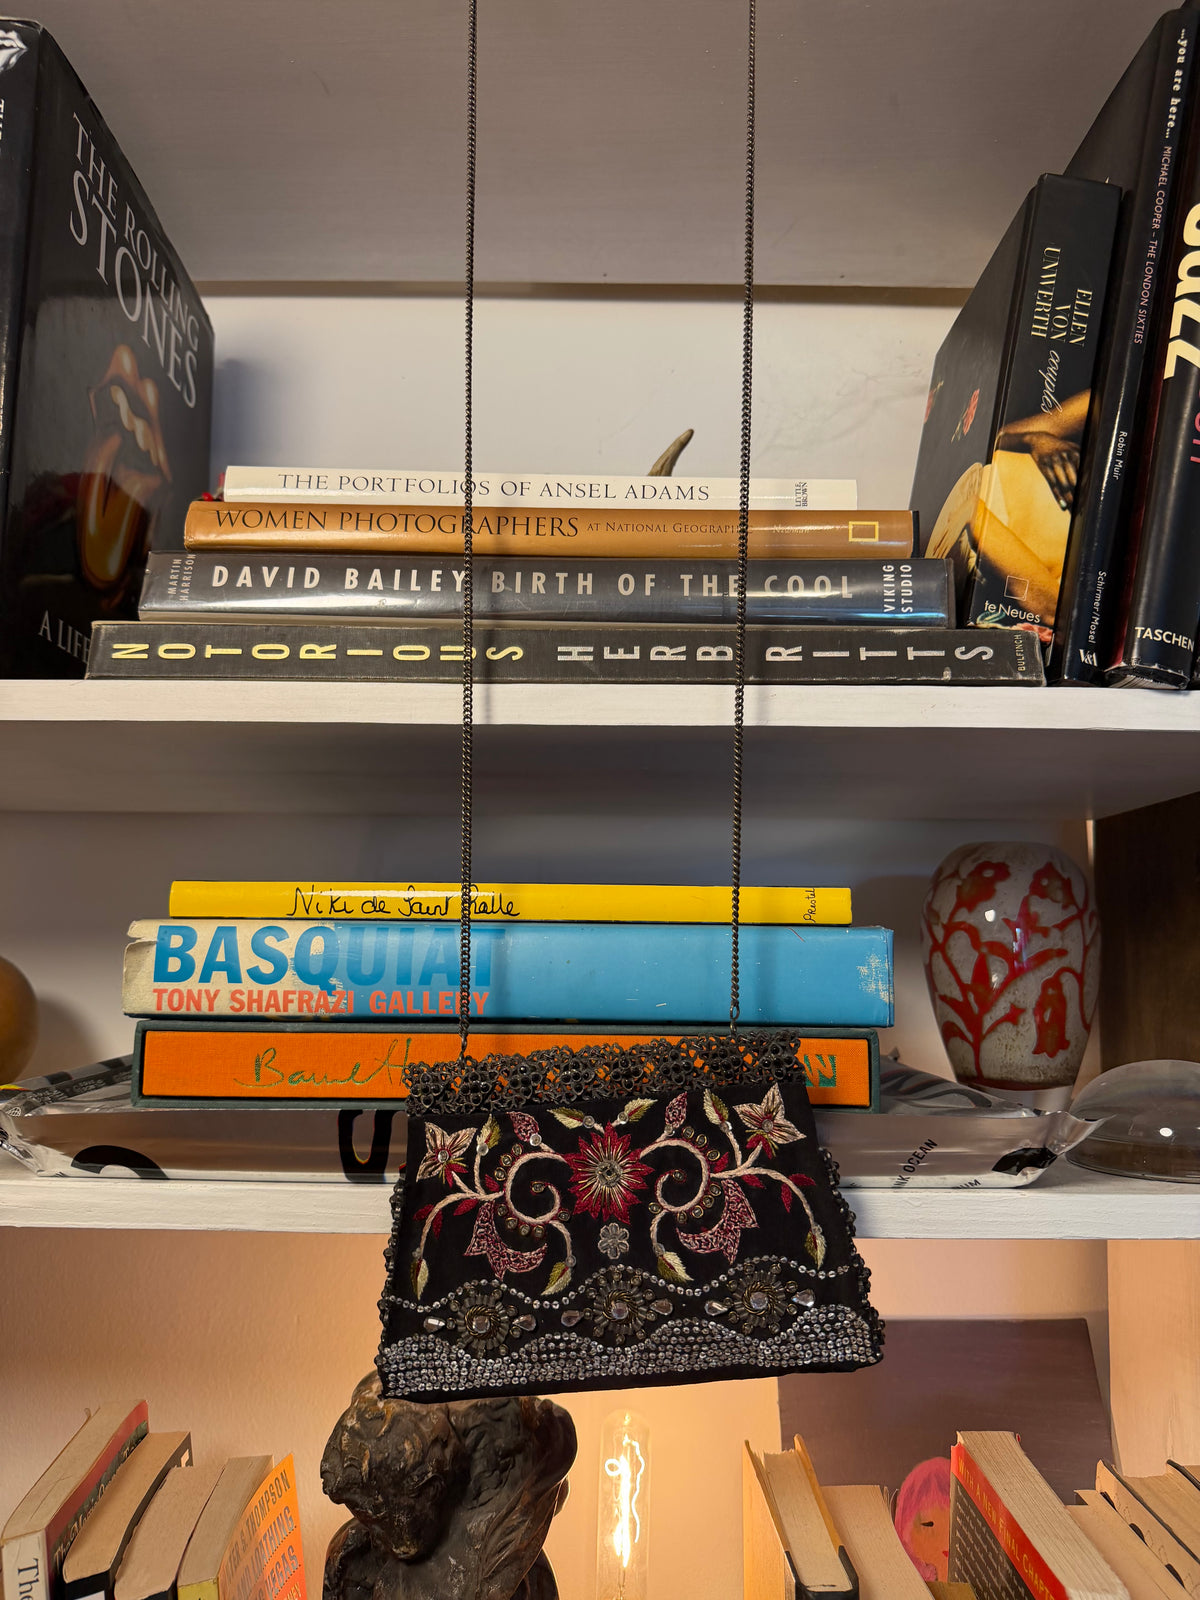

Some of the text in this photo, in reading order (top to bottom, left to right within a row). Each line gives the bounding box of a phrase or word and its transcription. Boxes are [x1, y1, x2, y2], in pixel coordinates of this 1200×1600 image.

[1172, 69, 1183, 91] are
[1157, 146, 1172, 188] MICHAEL
[73, 112, 200, 352] THE ROLLING
[1151, 190, 1165, 230] COOPER
[1147, 240, 1158, 259] THE
[69, 170, 198, 409] STONES
[1031, 247, 1061, 338] UNWERTH
[1140, 261, 1154, 307] LONDON
[1050, 304, 1071, 343] VON
[1069, 288, 1093, 347] ELLEN
[1133, 309, 1147, 345] SIXTIES
[1038, 350, 1063, 416] couples
[1113, 430, 1128, 481] Robin Muir
[278, 474, 709, 501] THE PORTFOLIOS OF ANSEL ADAMS
[215, 509, 327, 530] WOMEN
[339, 511, 579, 538] PHOTOGRAPHERS
[587, 522, 601, 532] AT
[605, 522, 669, 533] NATIONAL
[167, 559, 182, 595] MARTIN
[179, 554, 197, 601] HARRISON
[212, 565, 853, 599] DAVID BAILEY BIRTH OF THE COOL
[882, 564, 896, 613] VIKING
[900, 564, 914, 613] STUDIO
[38, 609, 91, 665] A LIFE
[111, 642, 994, 663] NOTORIOUS HERB RITTS
[1014, 634, 1026, 672] BULFINCH
[1135, 626, 1195, 653] TASCHEN
[286, 884, 354, 916] Niki
[361, 894, 392, 914] de
[153, 924, 506, 991] BASQUIAT
[152, 988, 221, 1012] TONY
[229, 989, 355, 1014] SHAFRAZI
[903, 1138, 938, 1173] OCEAN
[245, 1469, 291, 1541] THOMPSON
[250, 1505, 295, 1582] LOATHING
[957, 1457, 974, 1490] WITH
[976, 1483, 982, 1501] A
[983, 1493, 997, 1525] NEW
[998, 1516, 1021, 1562] FINAL
[1022, 1553, 1055, 1600] CHAPT
[264, 1544, 299, 1600] VEGAS
